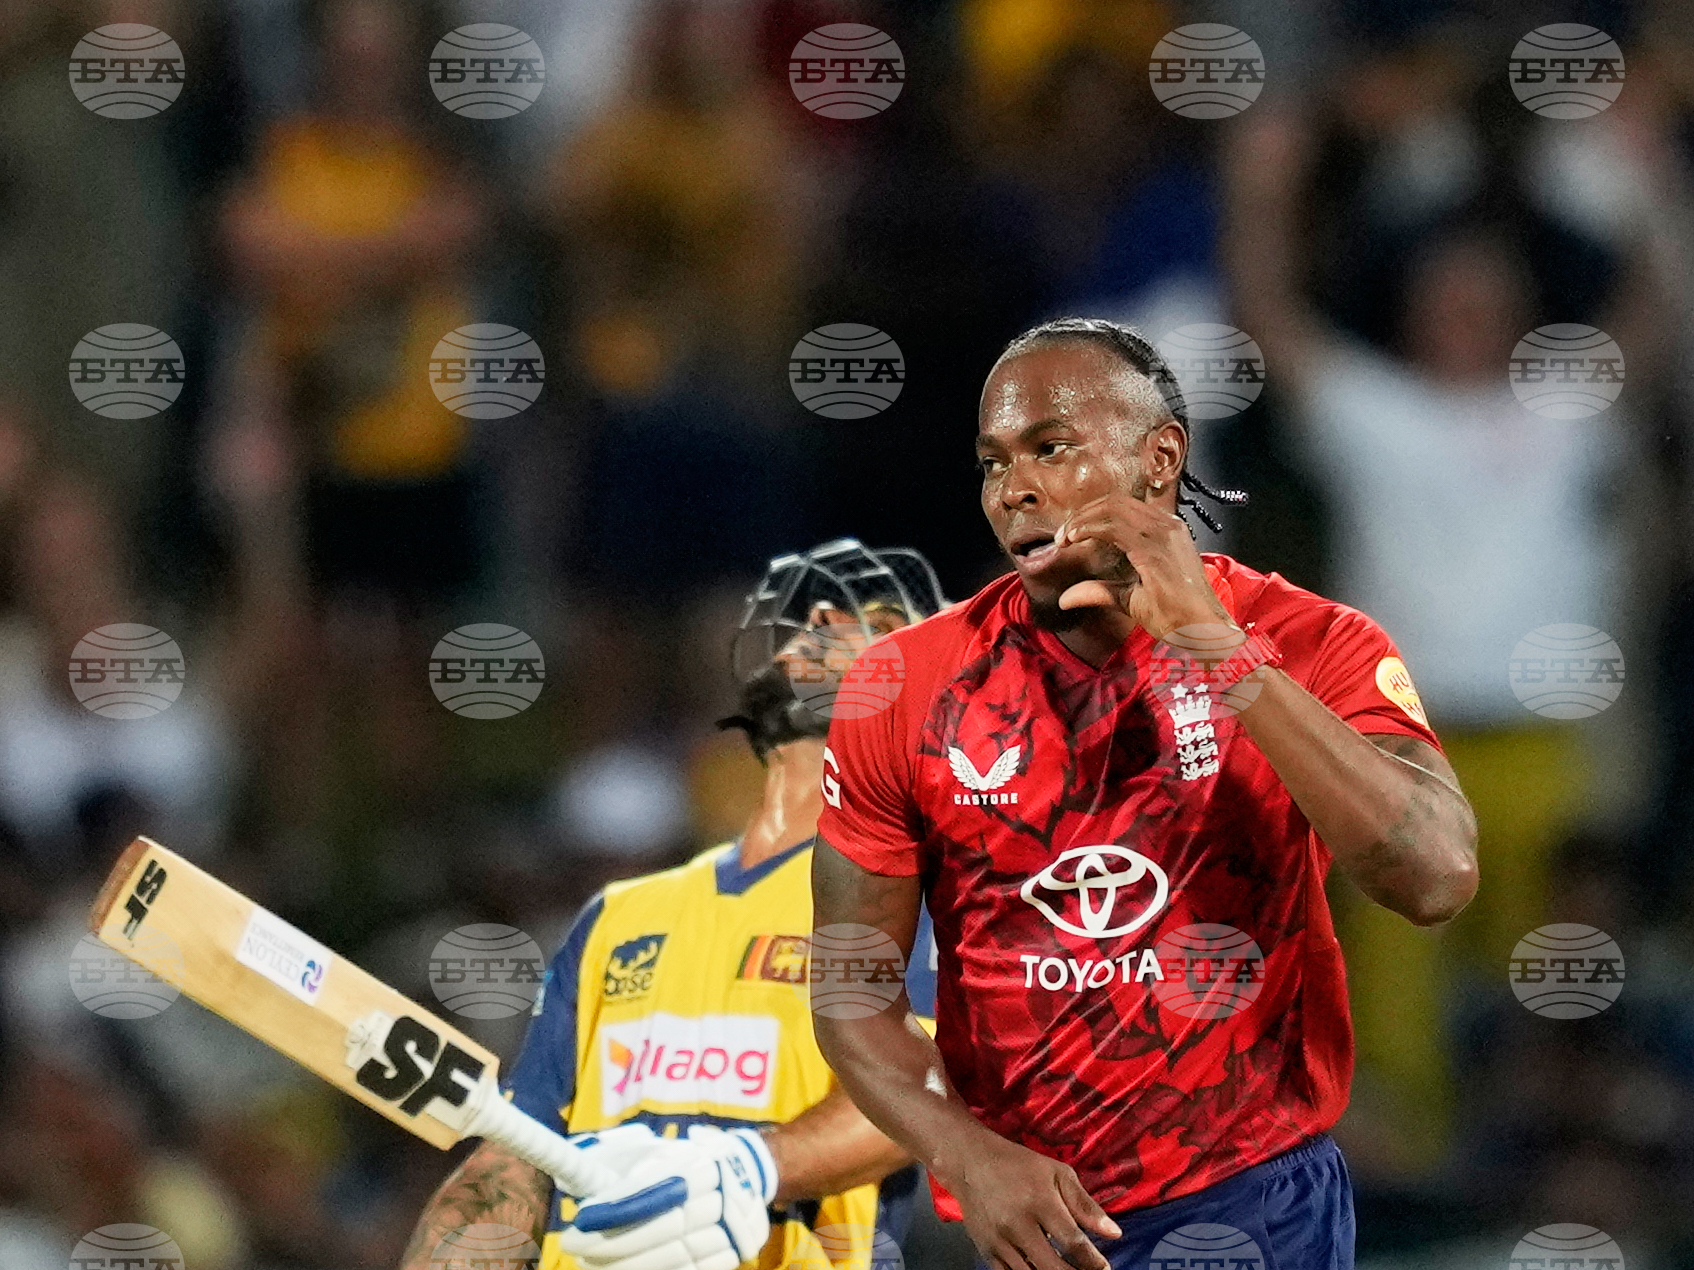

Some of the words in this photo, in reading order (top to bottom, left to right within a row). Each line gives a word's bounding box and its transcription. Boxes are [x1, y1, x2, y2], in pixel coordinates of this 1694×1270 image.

[954, 792, 1018, 806] CASTORE
[122, 858, 168, 941] SF
[1020, 948, 1164, 993] TOYOTA
[356, 1016, 486, 1117] SF
